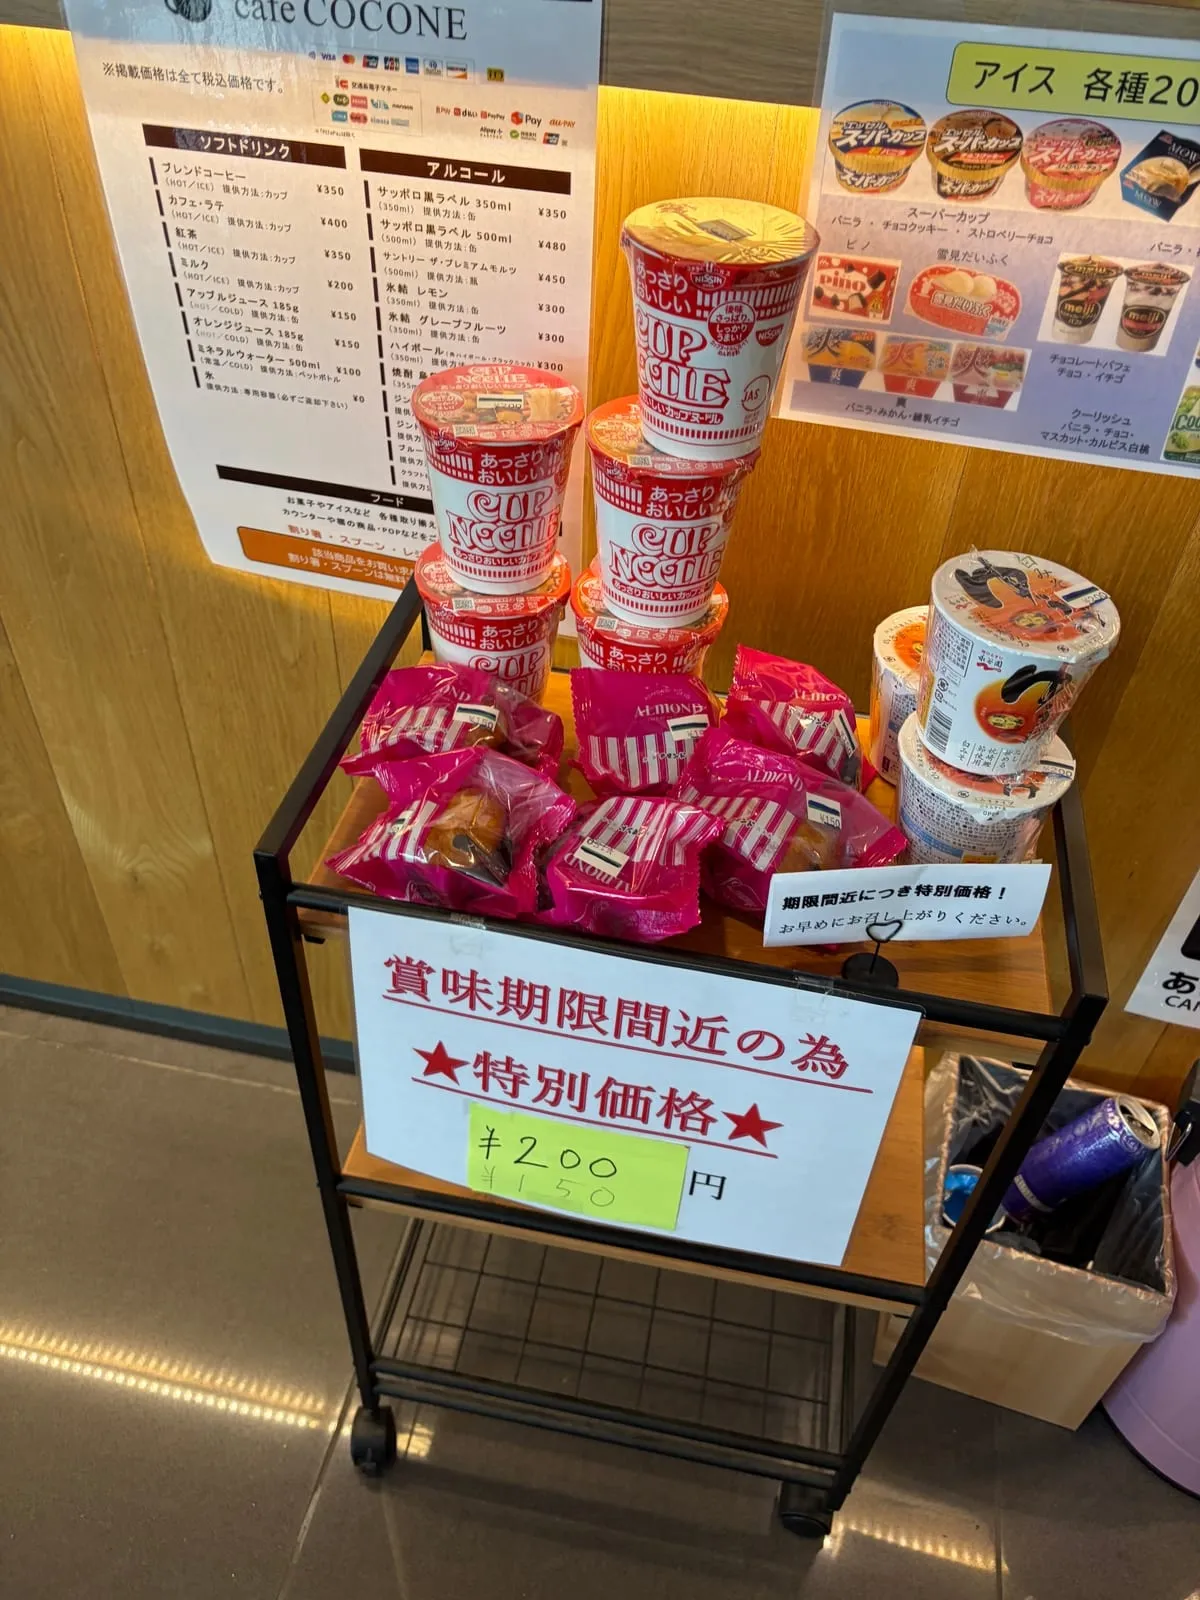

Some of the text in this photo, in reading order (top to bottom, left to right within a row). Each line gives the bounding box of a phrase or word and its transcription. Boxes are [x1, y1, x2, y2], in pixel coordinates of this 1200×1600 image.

[235, 0, 467, 40] cafe COCONE
[974, 60, 1057, 95] アイス
[200, 135, 290, 160] ソフトドリンク
[161, 162, 246, 181] ブレンドコーヒー
[426, 161, 506, 185] アルコール
[316, 183, 345, 196] ¥350
[168, 195, 224, 211] カフェ・ラテ
[377, 185, 512, 212] サッポロ黒ラベル 350ml
[538, 207, 567, 219] ¥350
[907, 206, 991, 225] スーパーカップ
[320, 216, 348, 229] ¥400
[175, 227, 198, 240] 紅茶
[379, 219, 513, 244] サッポロ黒ラベル 500ml
[538, 240, 566, 252] ¥480
[846, 240, 871, 251] ピノ
[181, 257, 209, 270] ミルク
[324, 249, 351, 261] ¥350
[383, 251, 425, 264] サントリー
[936, 248, 1009, 266] 雪見だいふく
[327, 279, 354, 291] ¥200
[538, 273, 566, 285] ¥450
[636, 259, 688, 294] あっさり
[819, 271, 867, 293] pino
[186, 287, 269, 308] アップルジュース
[386, 282, 449, 299] 氷結 レモン
[636, 279, 691, 314] おいしい
[330, 310, 357, 321] ¥150
[538, 303, 565, 315] ¥300
[1064, 302, 1096, 315] meiji
[1129, 310, 1161, 324] meiji
[193, 316, 274, 337] オレンジジュース
[388, 311, 507, 335] 氷結 グレープフルーツ
[334, 338, 360, 350] ¥150
[538, 332, 565, 344] ¥300
[289, 358, 321, 370] 500ml
[336, 366, 361, 377] ¥100
[537, 360, 564, 372] ¥300
[352, 394, 365, 403] ¥0
[1071, 408, 1132, 427] クーリッシュ
[480, 450, 545, 469] あっさり
[477, 467, 545, 484] おいしい
[370, 493, 404, 508] フード
[650, 484, 715, 504] あっさり
[466, 485, 554, 524] CUP
[646, 502, 715, 518] おいしい
[631, 522, 720, 559] CUP
[482, 621, 537, 639] あっさり
[479, 634, 540, 650] おいしい
[610, 646, 667, 666] あっさり
[634, 703, 706, 719] ALMOND
[744, 769, 804, 792] ALMOND
[819, 813, 841, 828] ¥150
[782, 884, 1006, 911] 期限間近につき特別価格!
[778, 909, 1028, 935] お早めにお召し上がりください。
[383, 953, 850, 1082] 賞味期限間近の為
[478, 1125, 618, 1179] ¥200
[689, 1169, 727, 1201] 円
